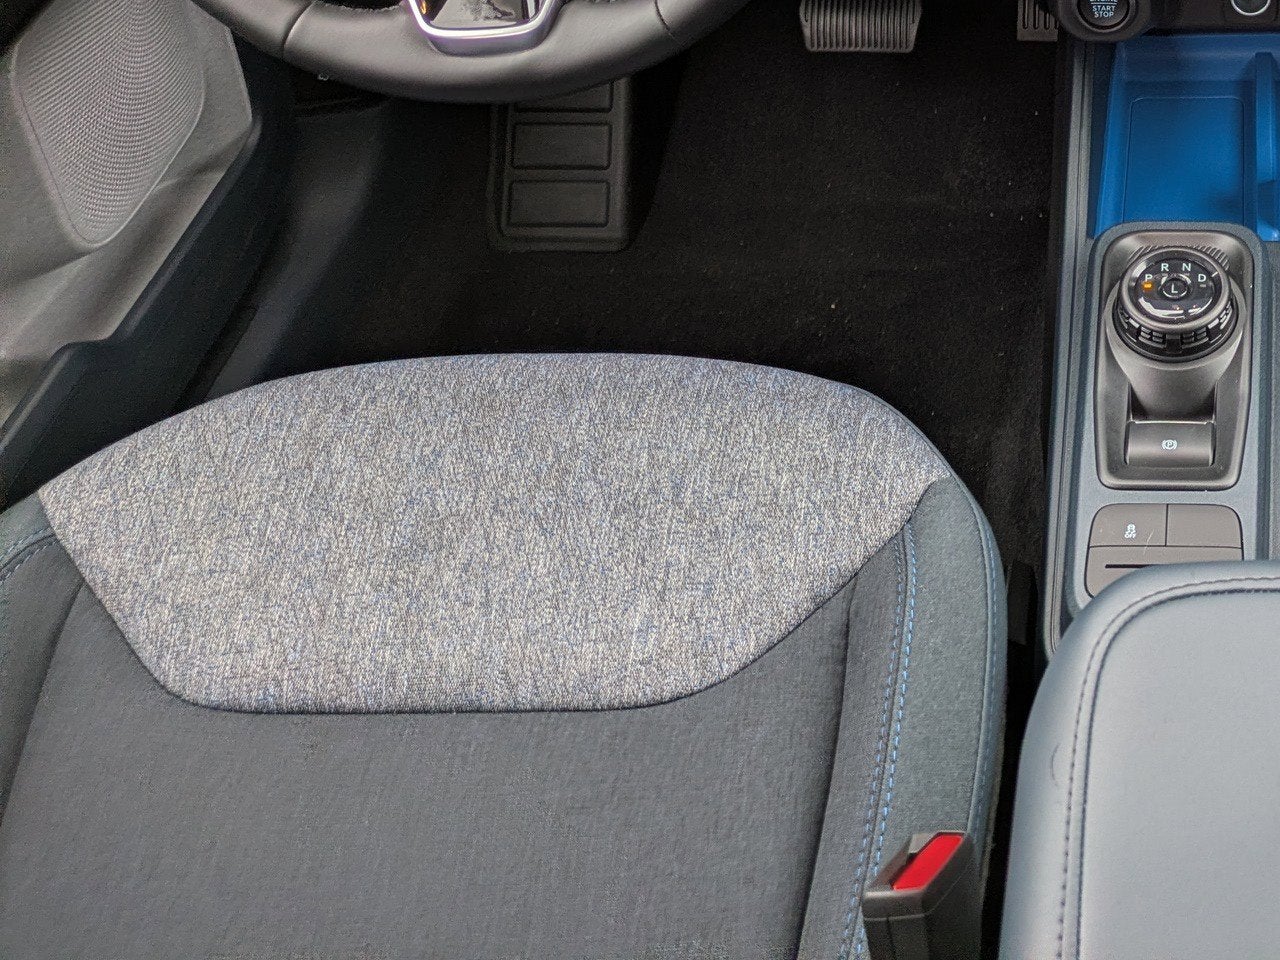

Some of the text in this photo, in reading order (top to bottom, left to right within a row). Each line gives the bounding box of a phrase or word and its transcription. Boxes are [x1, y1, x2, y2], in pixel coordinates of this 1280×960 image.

[1161, 263, 1169, 272] R
[1182, 263, 1191, 271] N
[1198, 273, 1206, 282] D
[1172, 283, 1178, 293] L
